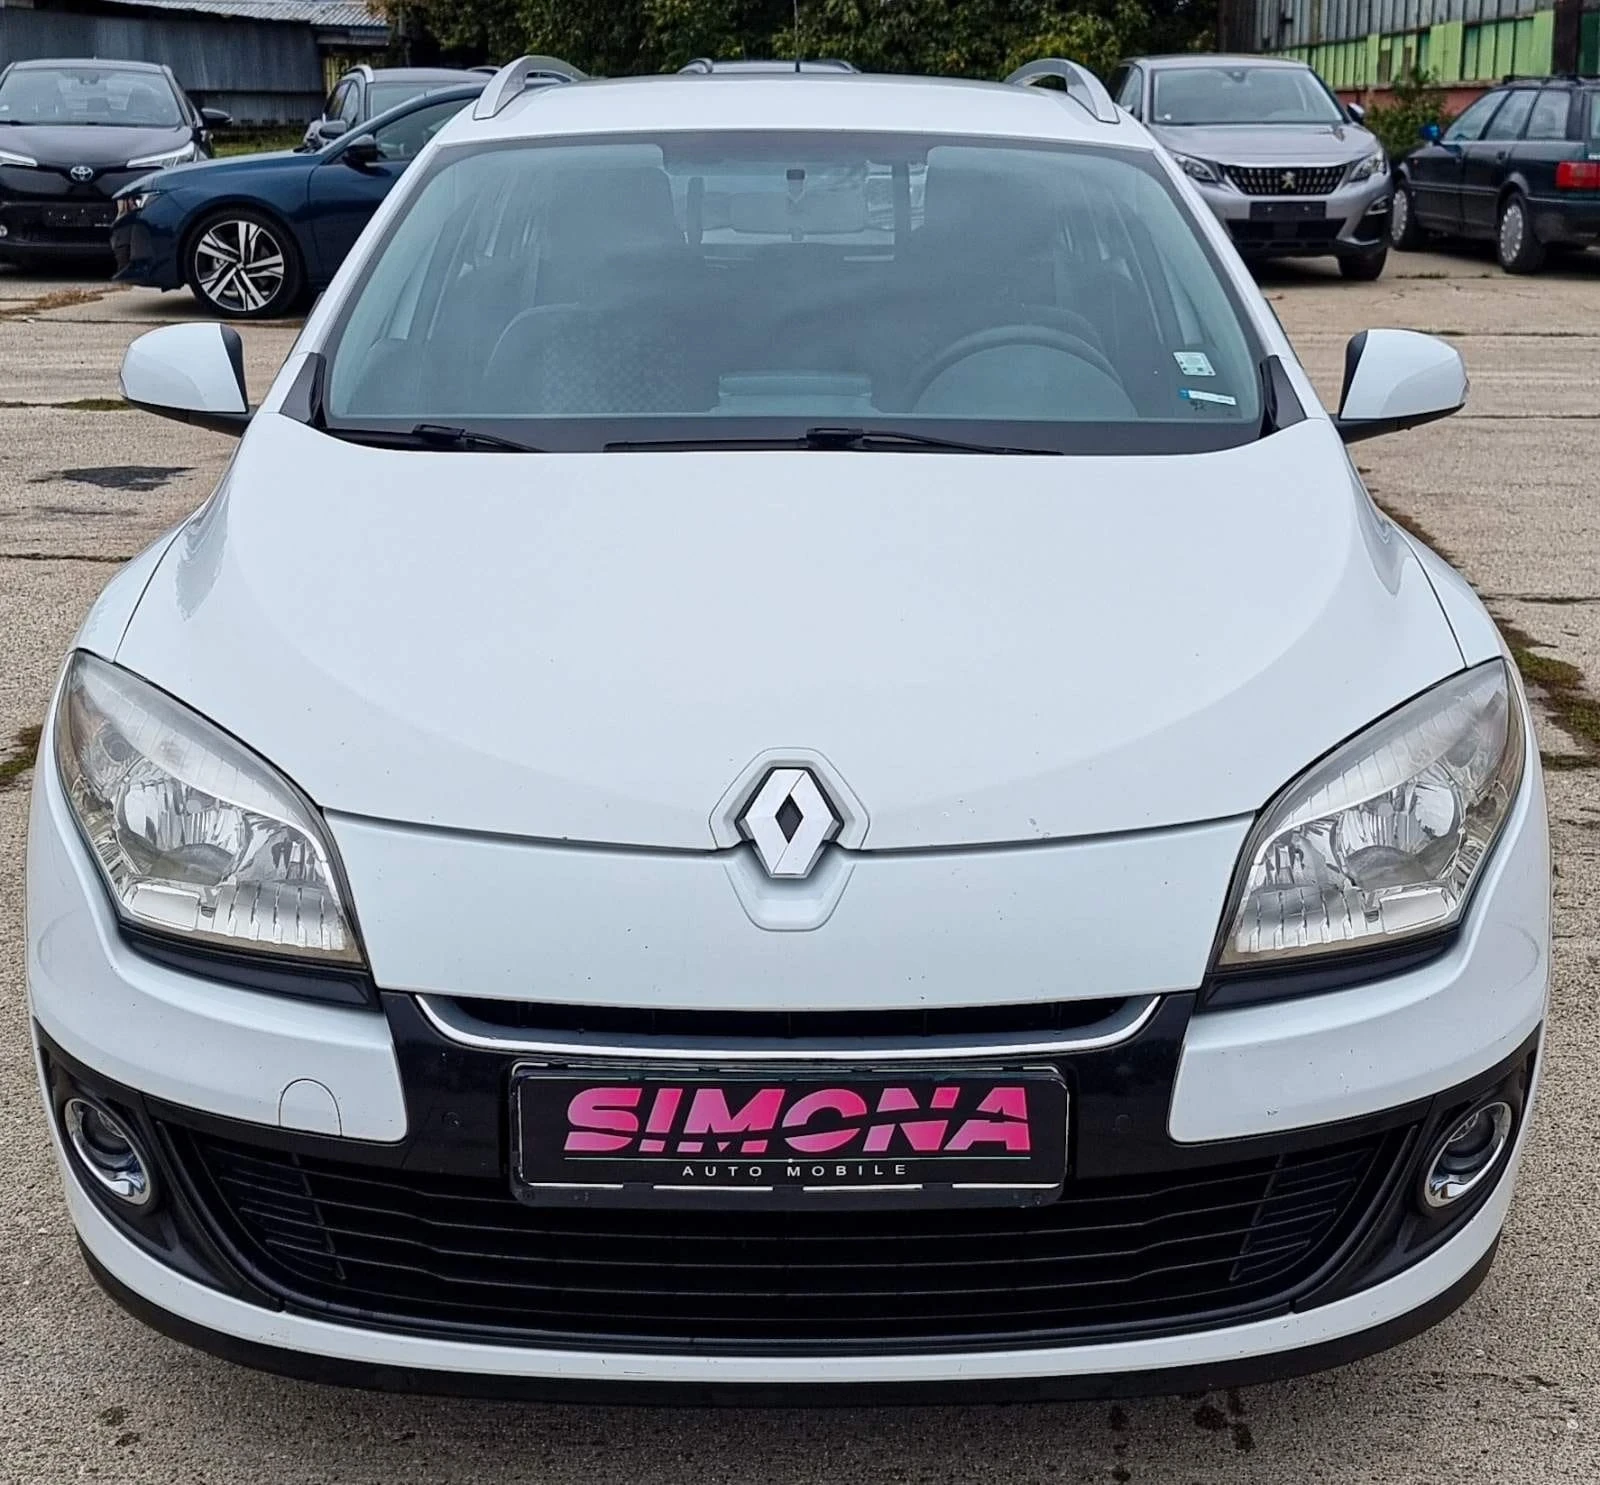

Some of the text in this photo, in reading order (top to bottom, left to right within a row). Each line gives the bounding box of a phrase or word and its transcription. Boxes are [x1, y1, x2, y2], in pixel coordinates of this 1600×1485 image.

[564, 1087, 1031, 1152] SIMONA
[682, 1164, 907, 1177] AUTO MOBILE
